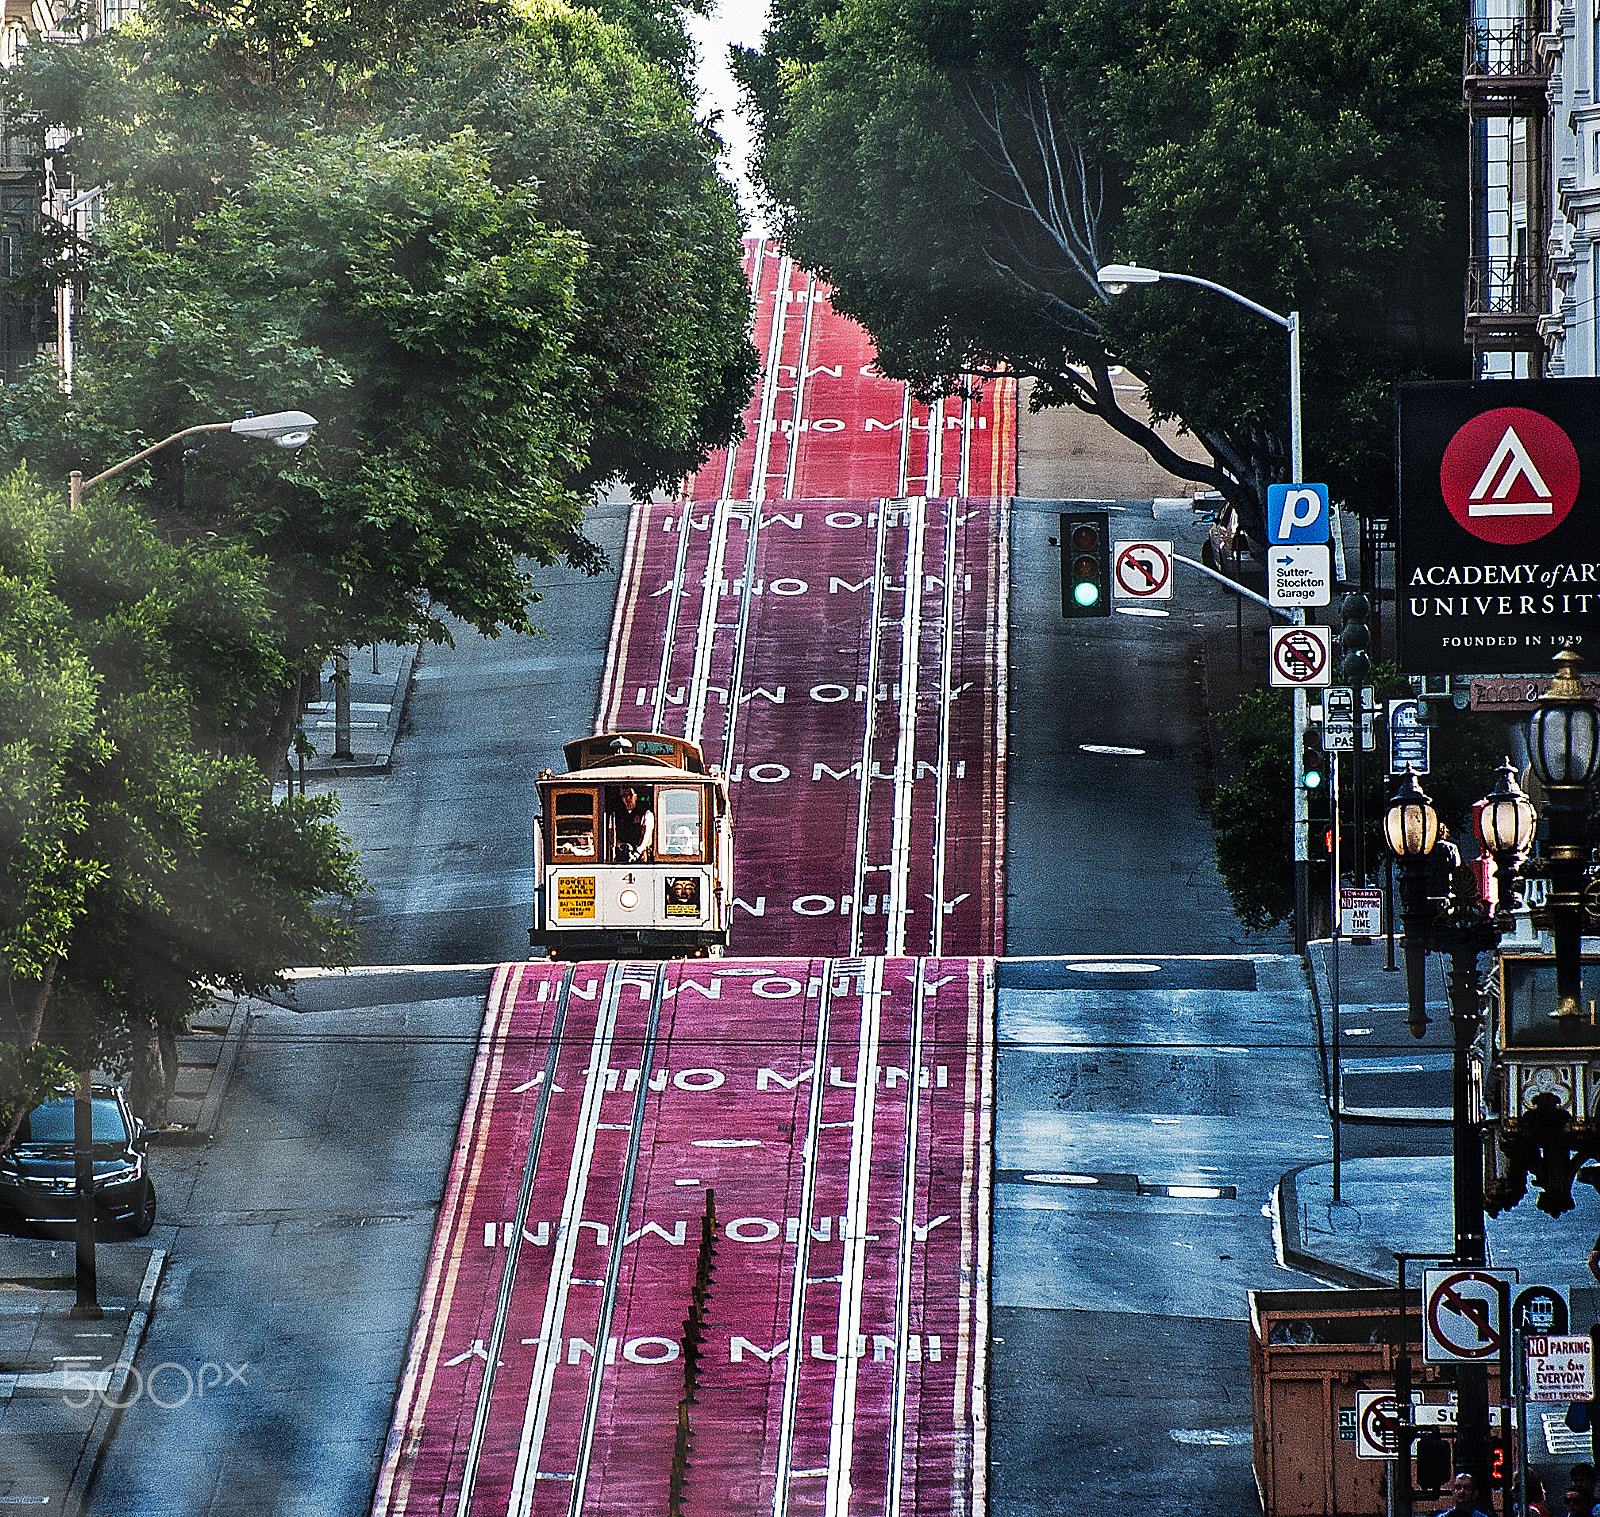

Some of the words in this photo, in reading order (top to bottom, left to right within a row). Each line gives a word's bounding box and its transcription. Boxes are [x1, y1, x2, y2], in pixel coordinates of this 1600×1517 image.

[752, 417, 846, 434] ONL
[864, 416, 987, 431] MUNI
[662, 512, 803, 532] MUNI
[824, 509, 981, 531] ONLY
[1276, 567, 1313, 578] Sutter-
[1276, 577, 1324, 588] Stockton
[1409, 564, 1539, 587] ACADEMY
[1540, 564, 1564, 589] of
[1562, 563, 1600, 583] AR
[649, 577, 809, 598] ONLY
[829, 573, 972, 594] MUNI
[1276, 588, 1315, 600] Garage
[1409, 594, 1600, 617] UNIVERSIT
[1442, 634, 1518, 648] FOUNDED
[1525, 634, 1542, 646] IN
[1549, 634, 1584, 646] 1929
[635, 685, 787, 706] MUNI
[809, 681, 974, 703] ONLY
[1334, 737, 1355, 747] PAS
[812, 760, 966, 781] MUNI
[622, 872, 636, 885] 4
[792, 893, 971, 916] ONLY
[1341, 897, 1353, 908] NO
[1351, 919, 1371, 929] TIME
[1352, 909, 1369, 919] ANY
[537, 977, 722, 1003] MUNI
[751, 975, 958, 999] ONLY
[510, 1067, 726, 1095] ONLY
[756, 1065, 948, 1091] MUNI
[483, 1220, 687, 1247] MUNI
[724, 1215, 951, 1243] ONLY
[443, 1336, 680, 1367] ONLY
[730, 1333, 942, 1363] MUNI
[1529, 1338, 1546, 1355] NO
[1550, 1341, 1591, 1355] PARKING
[1536, 1372, 1586, 1384] EVERYDAY
